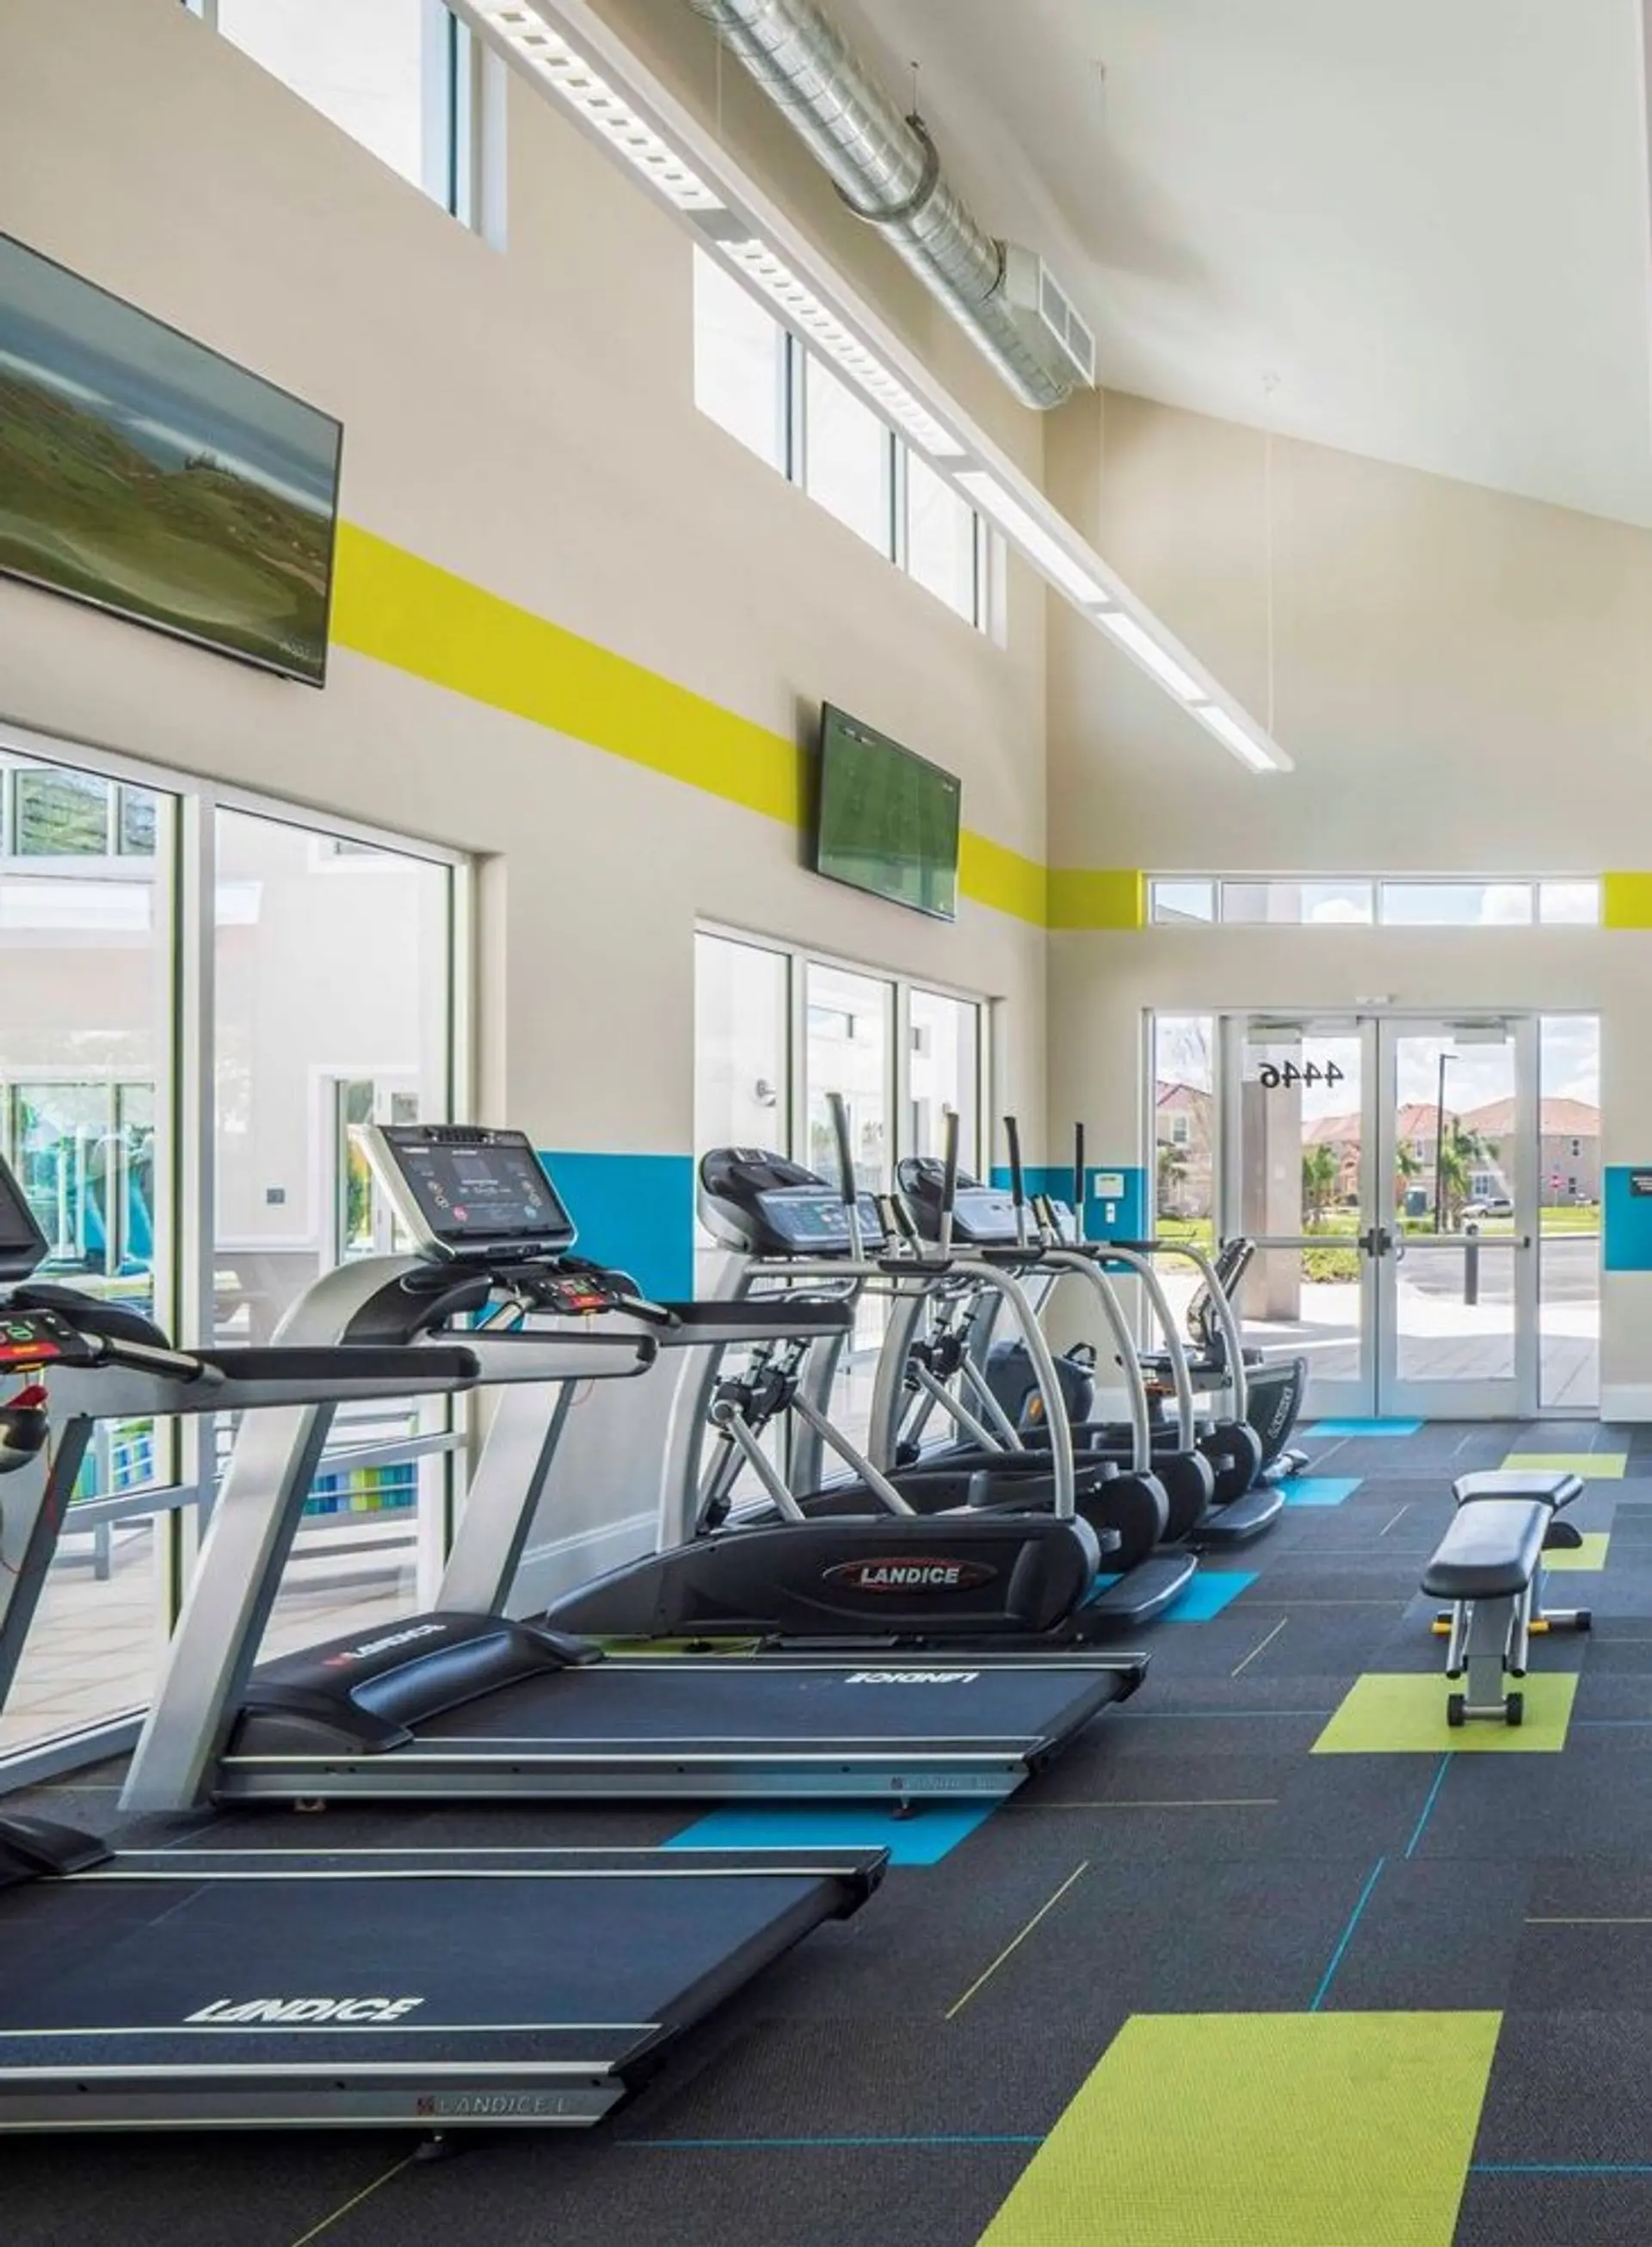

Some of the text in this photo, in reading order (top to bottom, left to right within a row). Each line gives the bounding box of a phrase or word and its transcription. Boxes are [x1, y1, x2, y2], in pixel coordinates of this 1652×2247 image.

[860, 1567, 959, 1584] LANDICE
[843, 1672, 980, 1683] LANDICE
[182, 1997, 425, 2022] LANDICE
[440, 2096, 548, 2114] LANDICE
